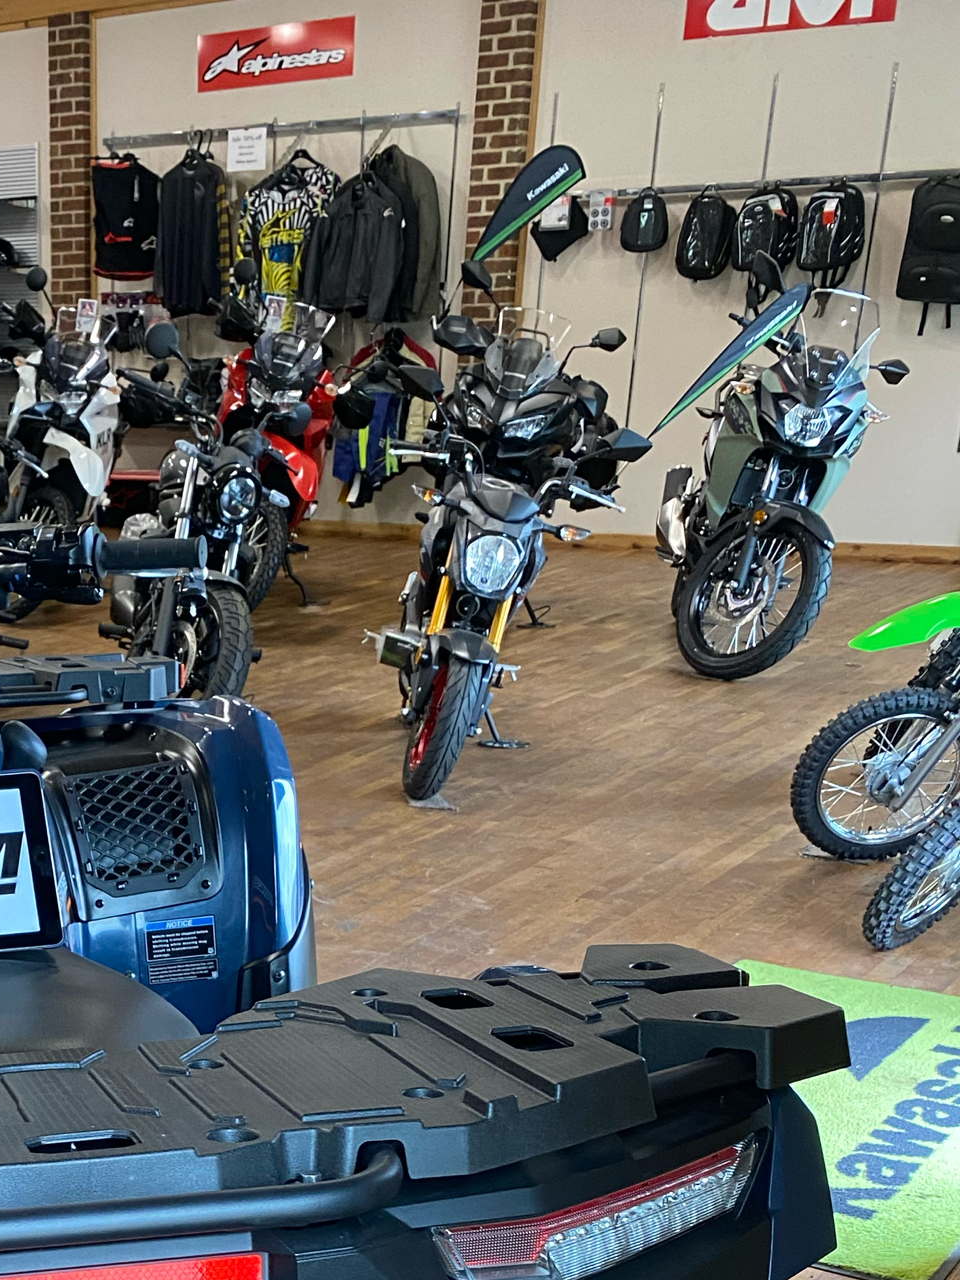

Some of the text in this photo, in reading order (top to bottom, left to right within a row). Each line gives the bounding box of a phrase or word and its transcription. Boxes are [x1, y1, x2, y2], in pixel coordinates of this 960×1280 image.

[240, 49, 346, 77] alpinestars
[526, 163, 570, 201] Kawasaki
[166, 920, 192, 928] NOTICE
